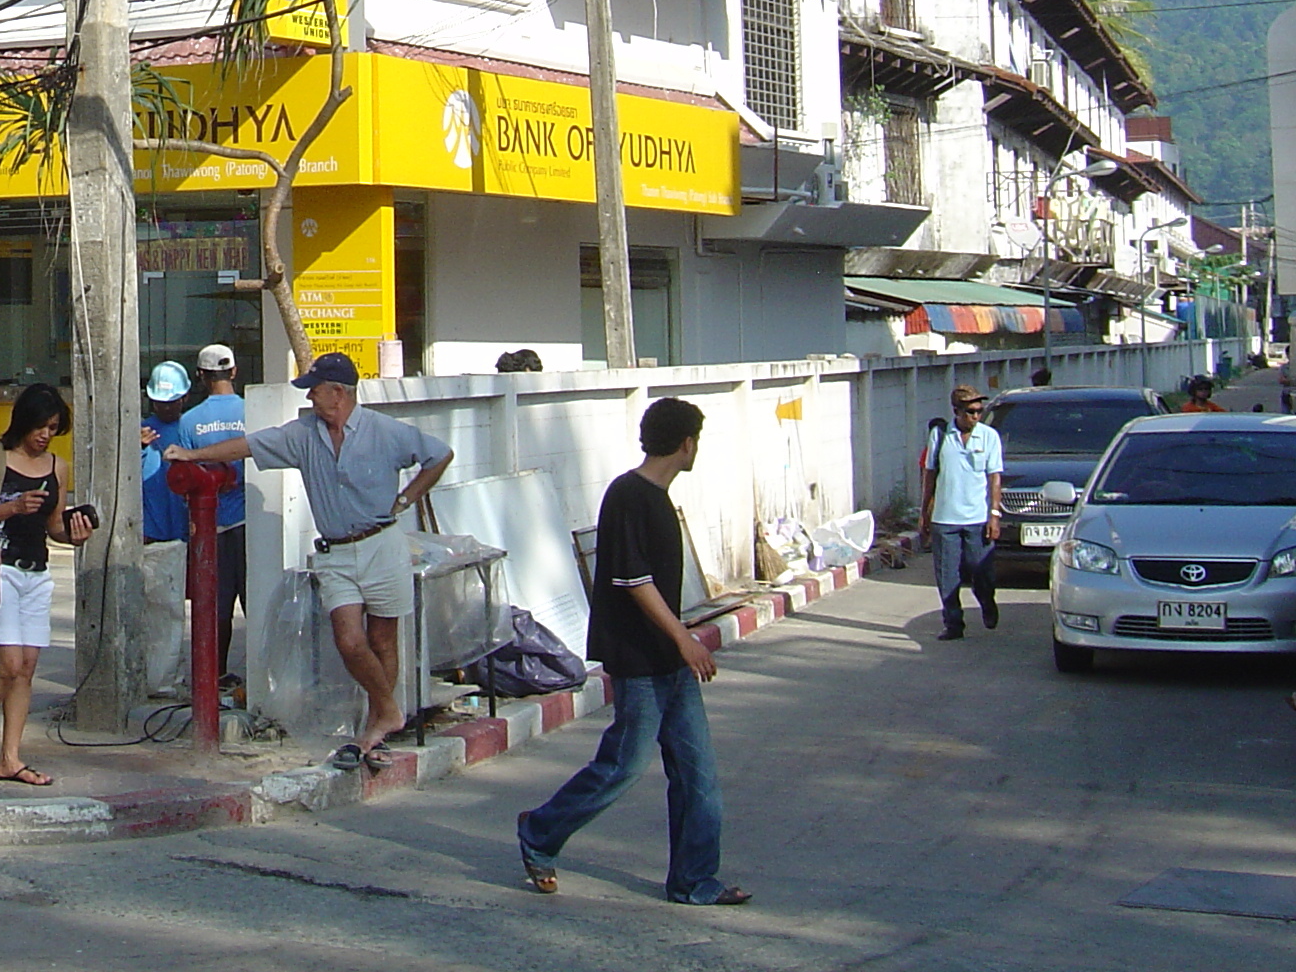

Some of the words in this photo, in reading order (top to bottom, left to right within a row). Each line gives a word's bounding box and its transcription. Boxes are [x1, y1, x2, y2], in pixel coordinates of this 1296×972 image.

[497, 114, 557, 158] BANK
[567, 124, 593, 162] OF
[225, 160, 268, 180] (Patong)
[298, 156, 339, 173] Branch
[299, 292, 323, 302] ATM
[299, 308, 355, 319] EXCHANGE
[1043, 526, 1066, 537] 877
[1188, 603, 1222, 618] 8204
